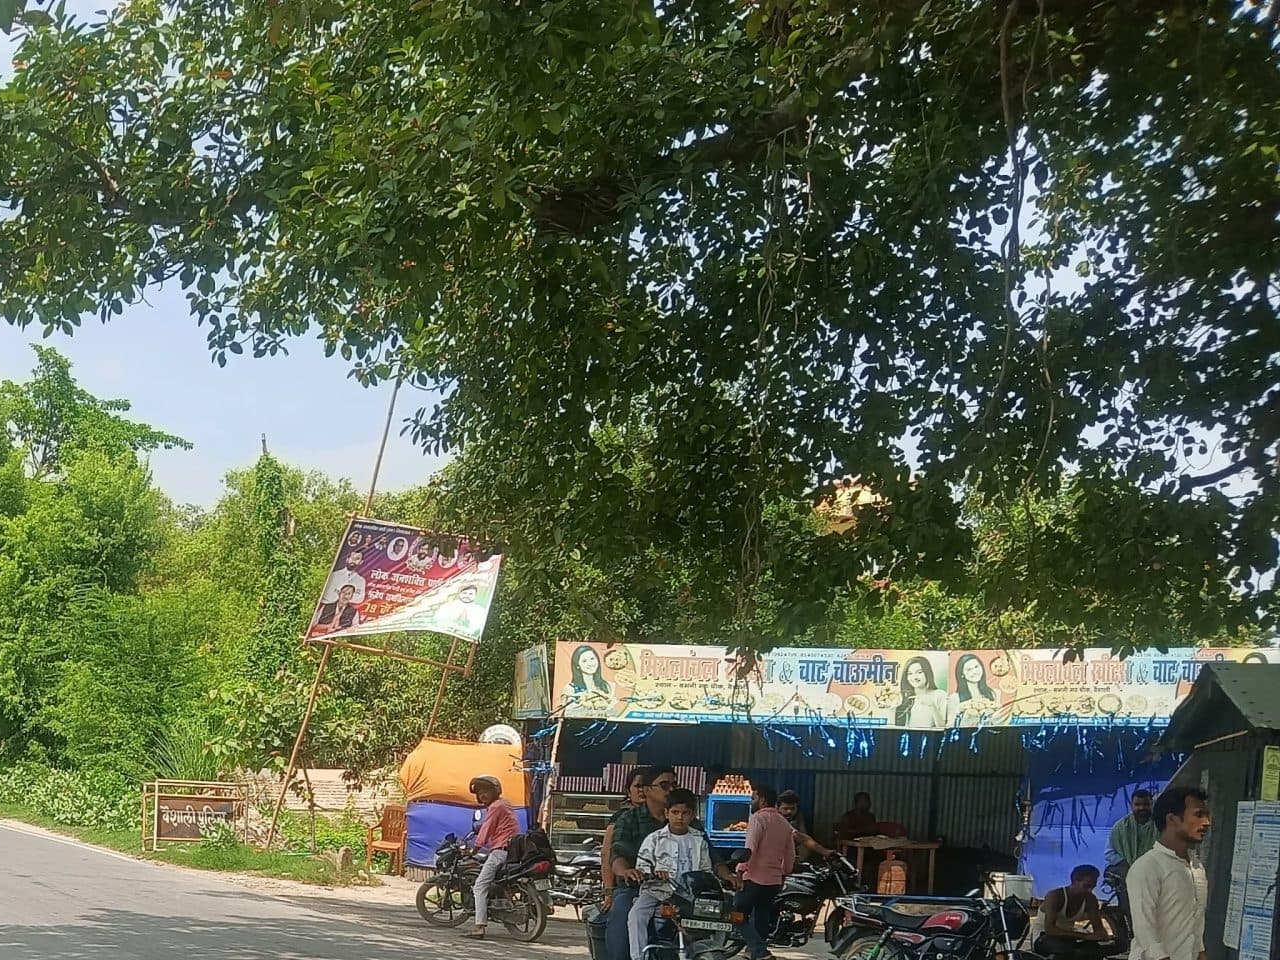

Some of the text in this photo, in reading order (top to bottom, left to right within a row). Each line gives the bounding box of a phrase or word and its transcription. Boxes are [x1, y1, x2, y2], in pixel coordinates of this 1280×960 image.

[799, 660, 829, 685] चाट
[833, 655, 900, 686] चाऊमीन
[1152, 660, 1180, 685] चाट
[160, 804, 195, 828] वैशाली
